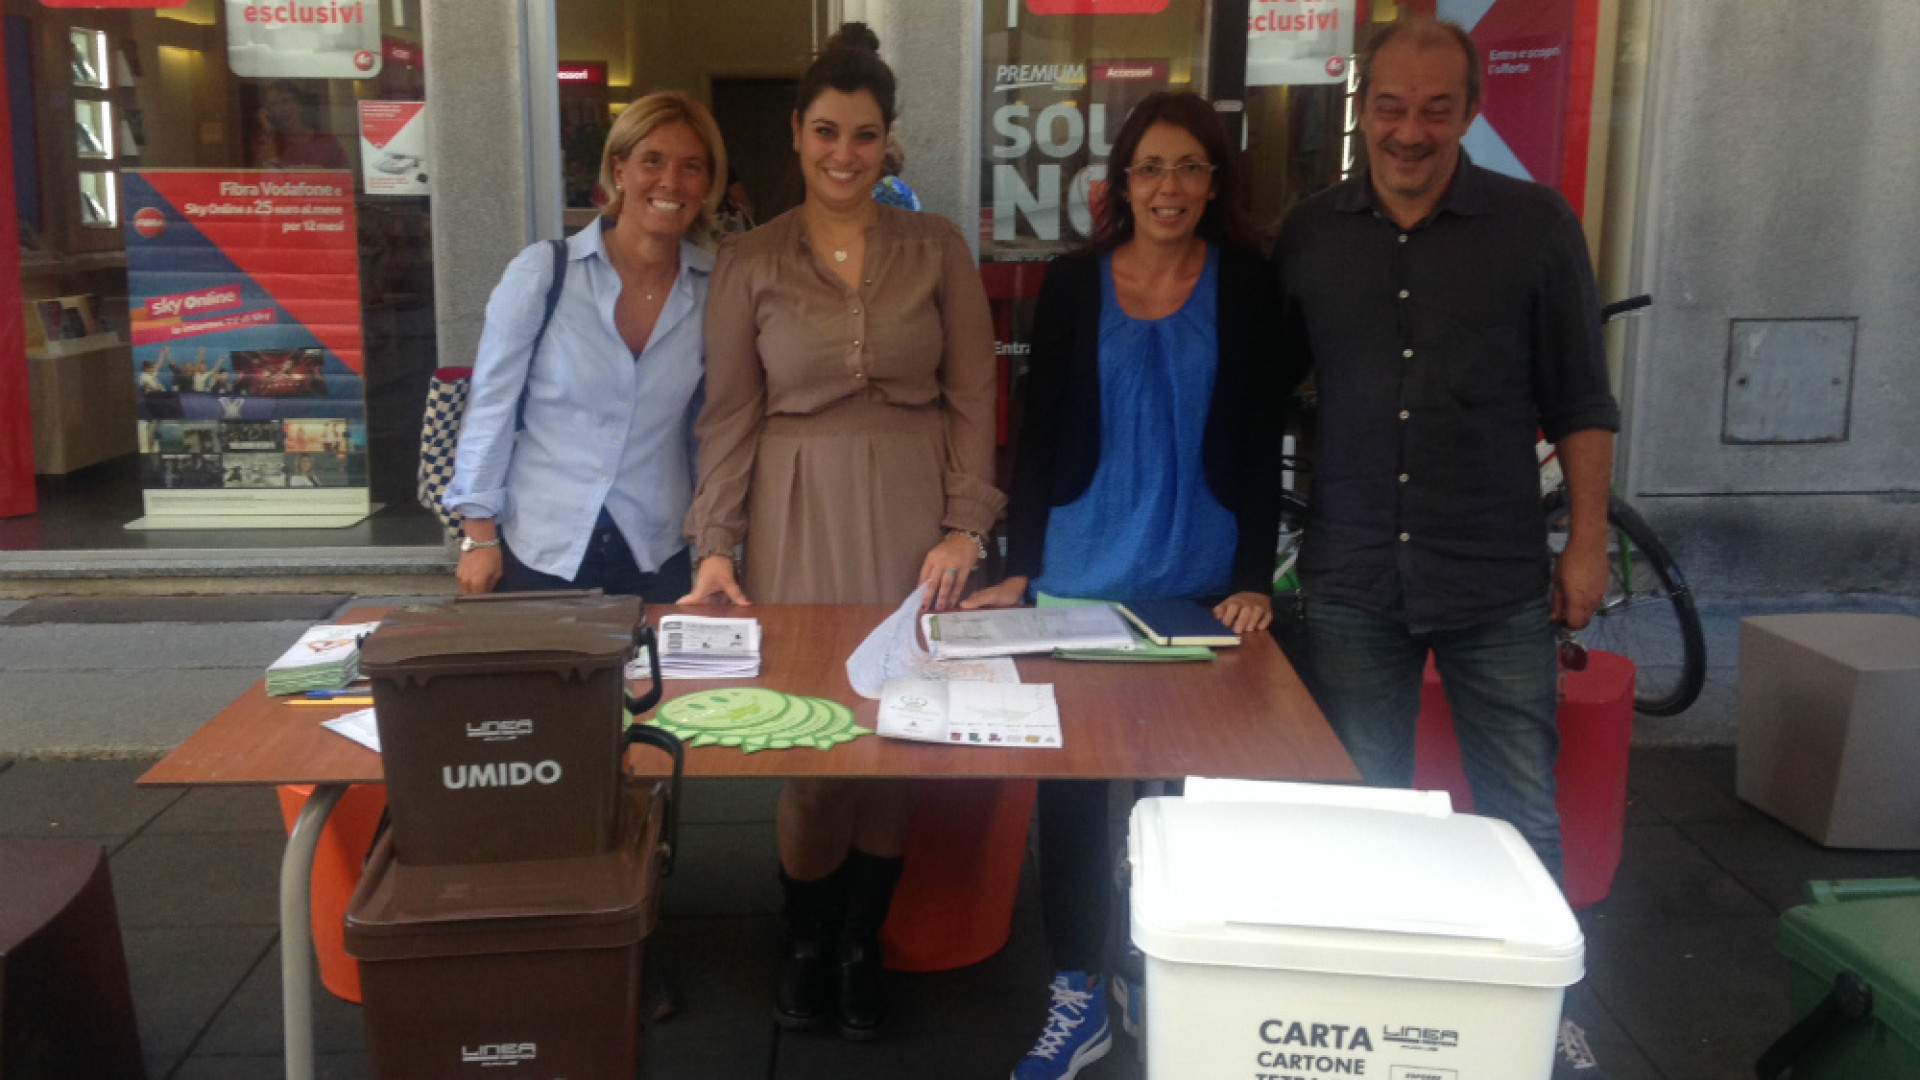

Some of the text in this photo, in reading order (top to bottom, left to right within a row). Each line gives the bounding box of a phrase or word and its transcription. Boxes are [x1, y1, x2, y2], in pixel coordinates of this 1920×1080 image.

[244, 1, 364, 24] esclusivi
[995, 64, 1085, 82] PREMIUM
[992, 102, 1114, 158] SOL
[219, 181, 259, 197] Fibra
[261, 181, 332, 197] Vodafone
[254, 200, 273, 215] 25
[184, 290, 236, 310] Online
[442, 760, 562, 789] UMIDO
[1258, 1019, 1374, 1051] CARTA
[1256, 1051, 1366, 1075] CARTONE
